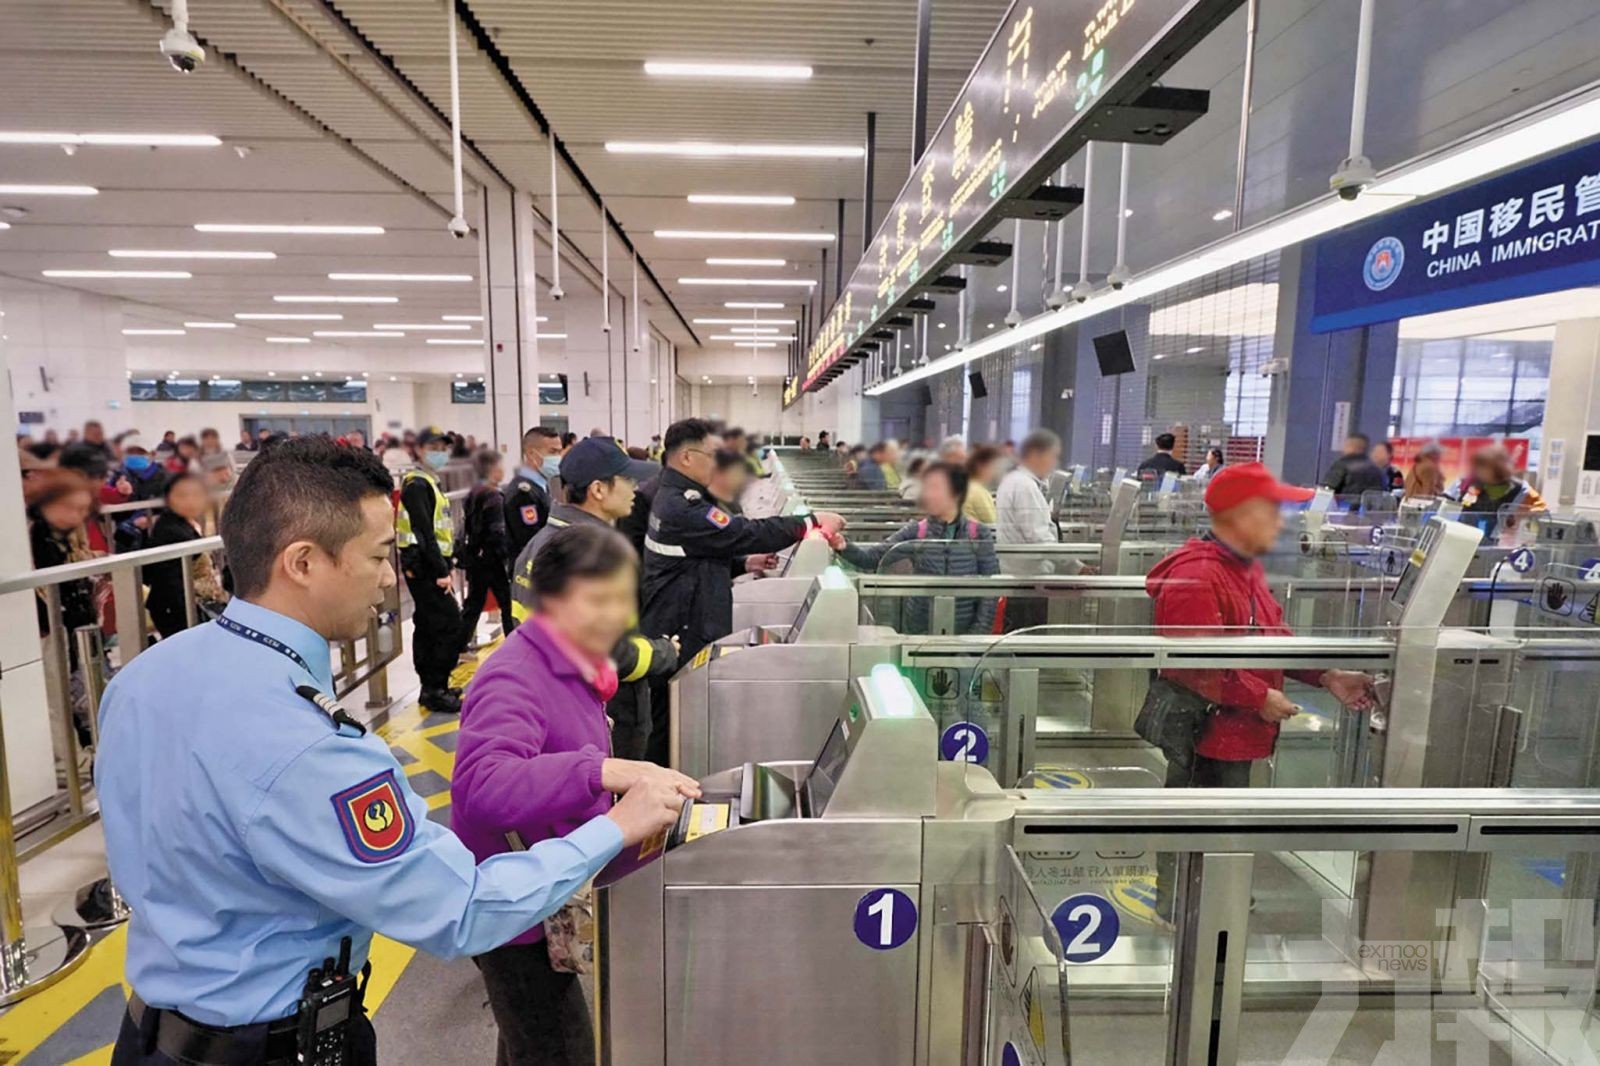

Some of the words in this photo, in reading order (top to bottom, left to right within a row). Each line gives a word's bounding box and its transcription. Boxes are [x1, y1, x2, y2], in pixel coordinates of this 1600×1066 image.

[1422, 172, 1600, 255] 中国移民管
[1427, 251, 1481, 278] CHINA
[1491, 219, 1600, 263] IMMIGRAT
[1372, 528, 1382, 543] 5
[1514, 550, 1528, 570] 4
[953, 729, 977, 762] 2
[868, 893, 894, 946] 1
[1066, 904, 1102, 954] 2
